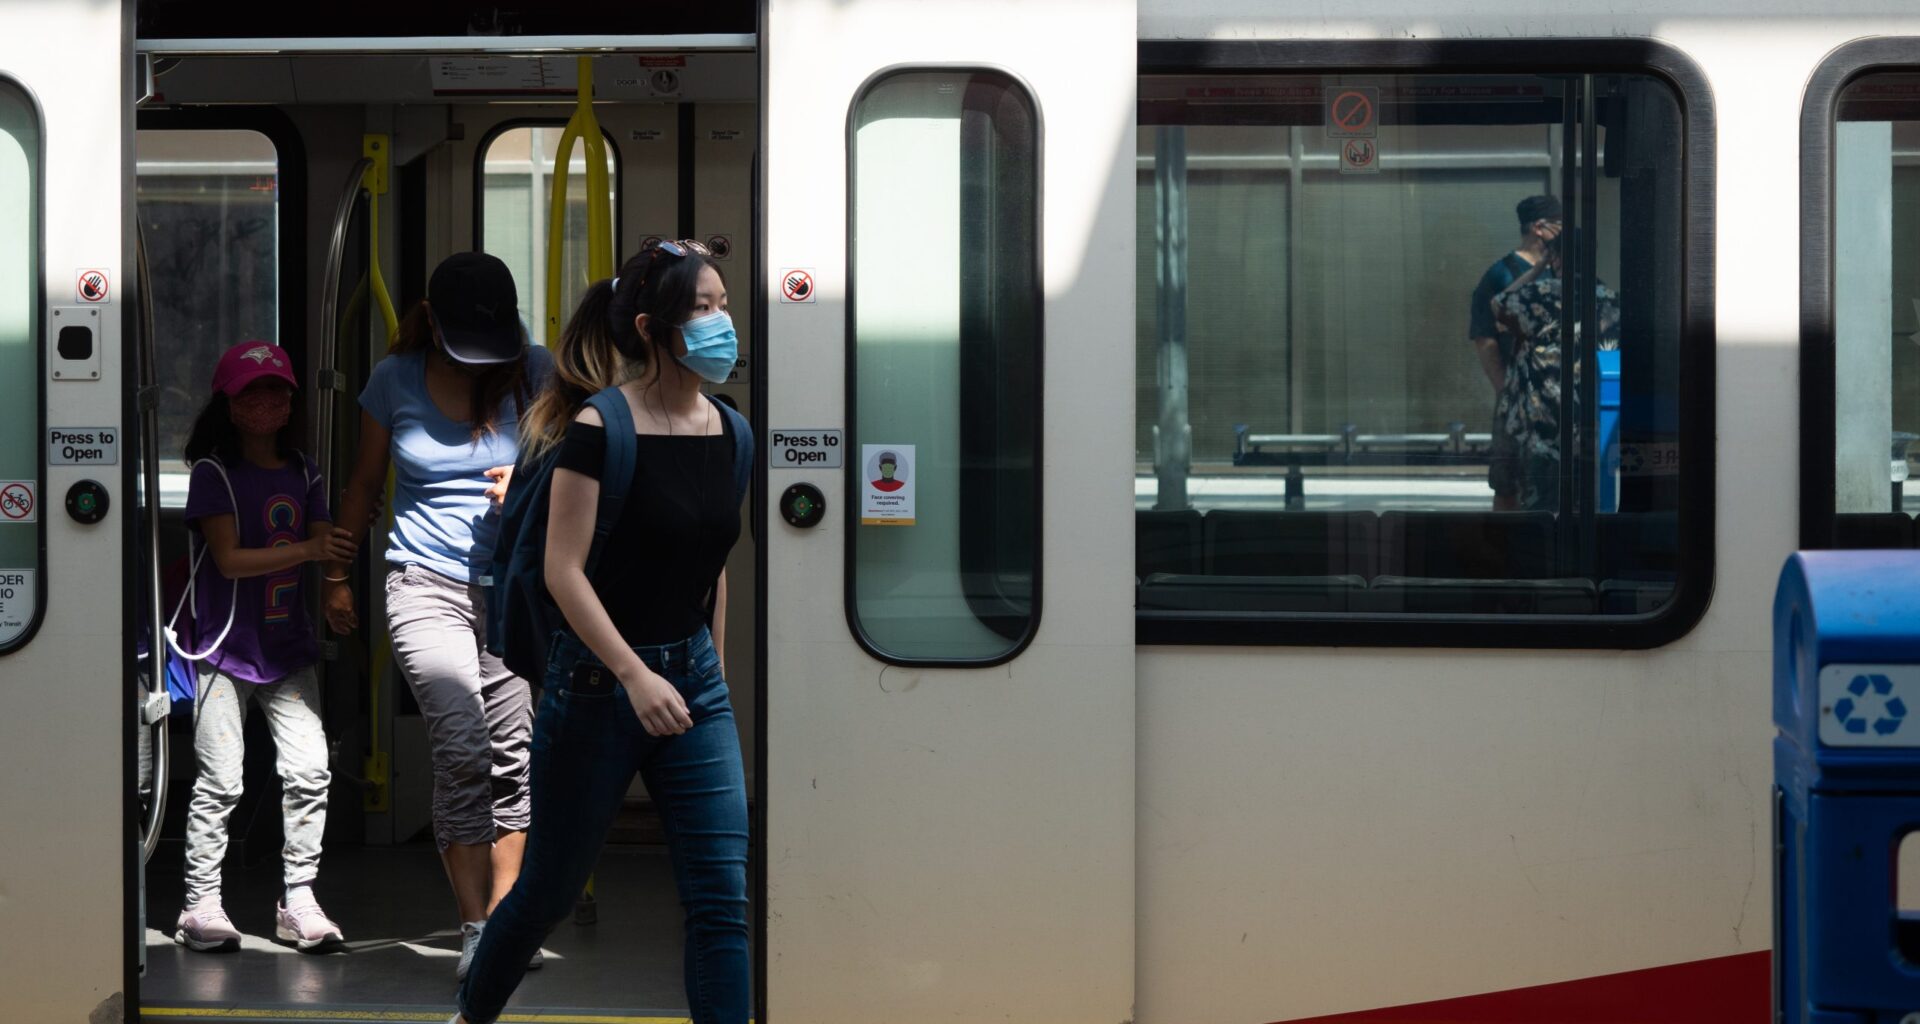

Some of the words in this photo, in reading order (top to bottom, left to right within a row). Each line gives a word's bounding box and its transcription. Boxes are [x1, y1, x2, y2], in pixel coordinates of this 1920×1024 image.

[51, 432, 94, 445] Press
[99, 432, 114, 445] to
[773, 434, 818, 447] Press
[823, 434, 839, 447] to
[62, 446, 103, 462] Open
[785, 449, 827, 464] Open
